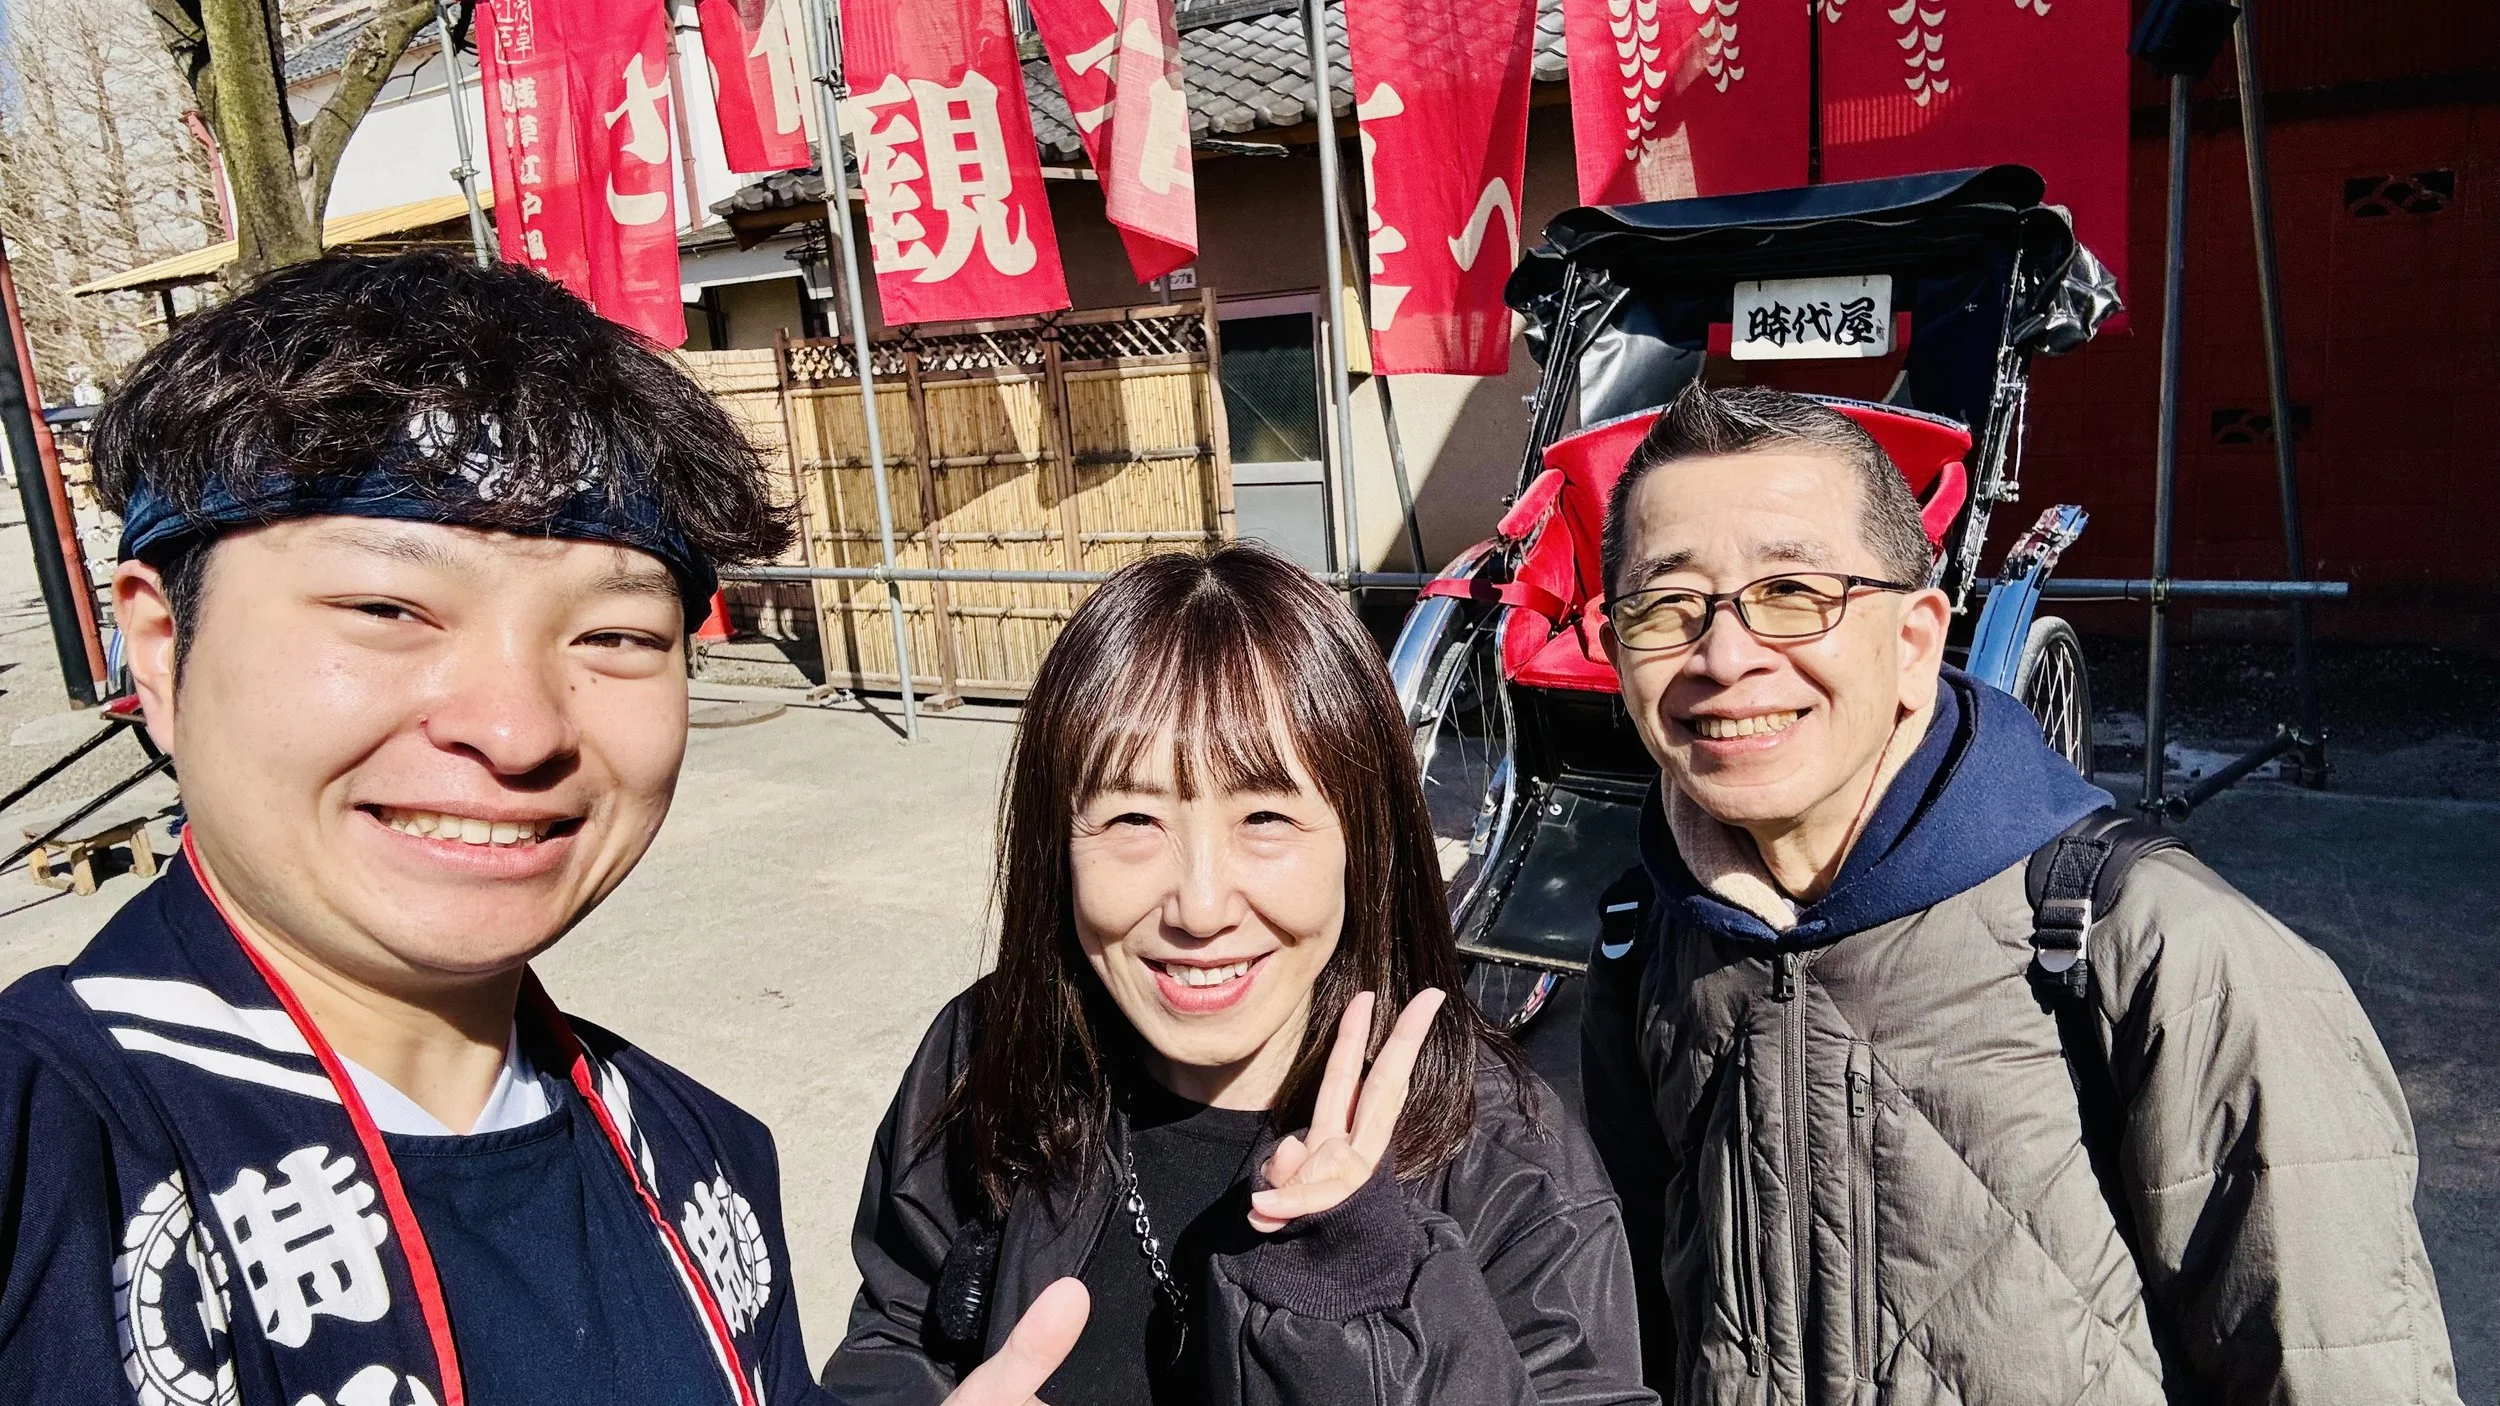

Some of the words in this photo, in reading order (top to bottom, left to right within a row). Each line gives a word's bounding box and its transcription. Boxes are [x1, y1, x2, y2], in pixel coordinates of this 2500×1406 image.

[847, 70, 1037, 283] 観
[1745, 297, 1876, 348] 時代屋
[210, 1146, 437, 1406] 時
